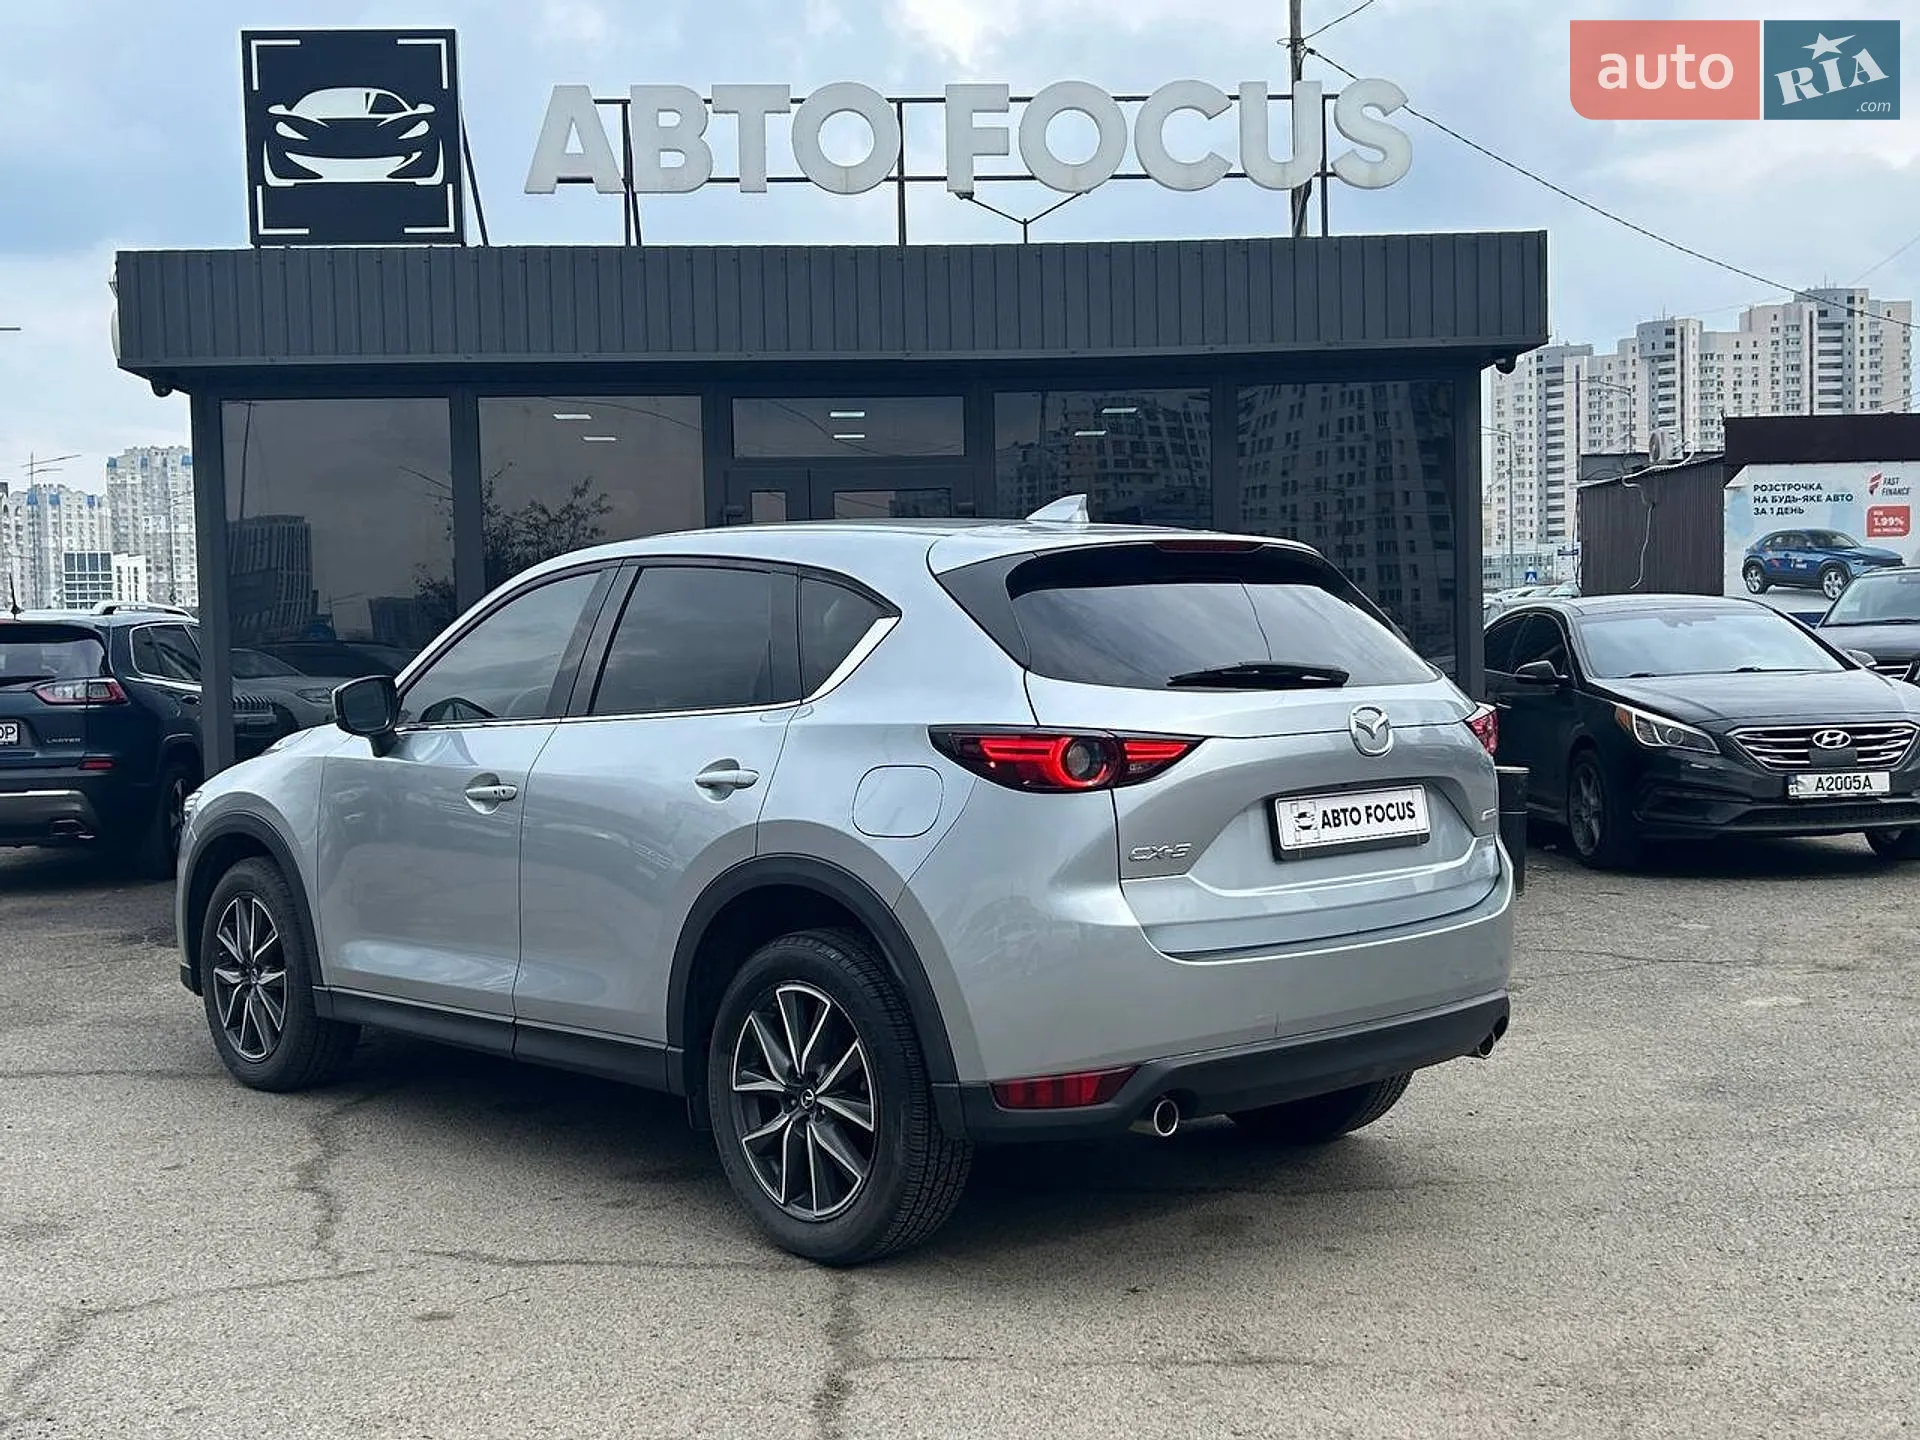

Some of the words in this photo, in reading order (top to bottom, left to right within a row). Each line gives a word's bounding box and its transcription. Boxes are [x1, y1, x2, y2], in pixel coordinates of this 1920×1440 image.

[524, 80, 901, 195] АВТО
[945, 78, 1413, 193] FOCUS
[1753, 483, 1823, 492] РОЗСТРОЧКА
[1753, 496, 1768, 504] НА
[1771, 494, 1823, 504] БУДЬ-ЯКЕ
[1825, 493, 1854, 503] АВТО
[1753, 507, 1767, 516] ЗА
[1776, 507, 1805, 516] ДЕНЬ
[1815, 775, 1873, 791] A2005A
[1321, 807, 1362, 829] АВТО
[1365, 801, 1416, 824] FOCUS
[1128, 841, 1192, 862] CX-5
